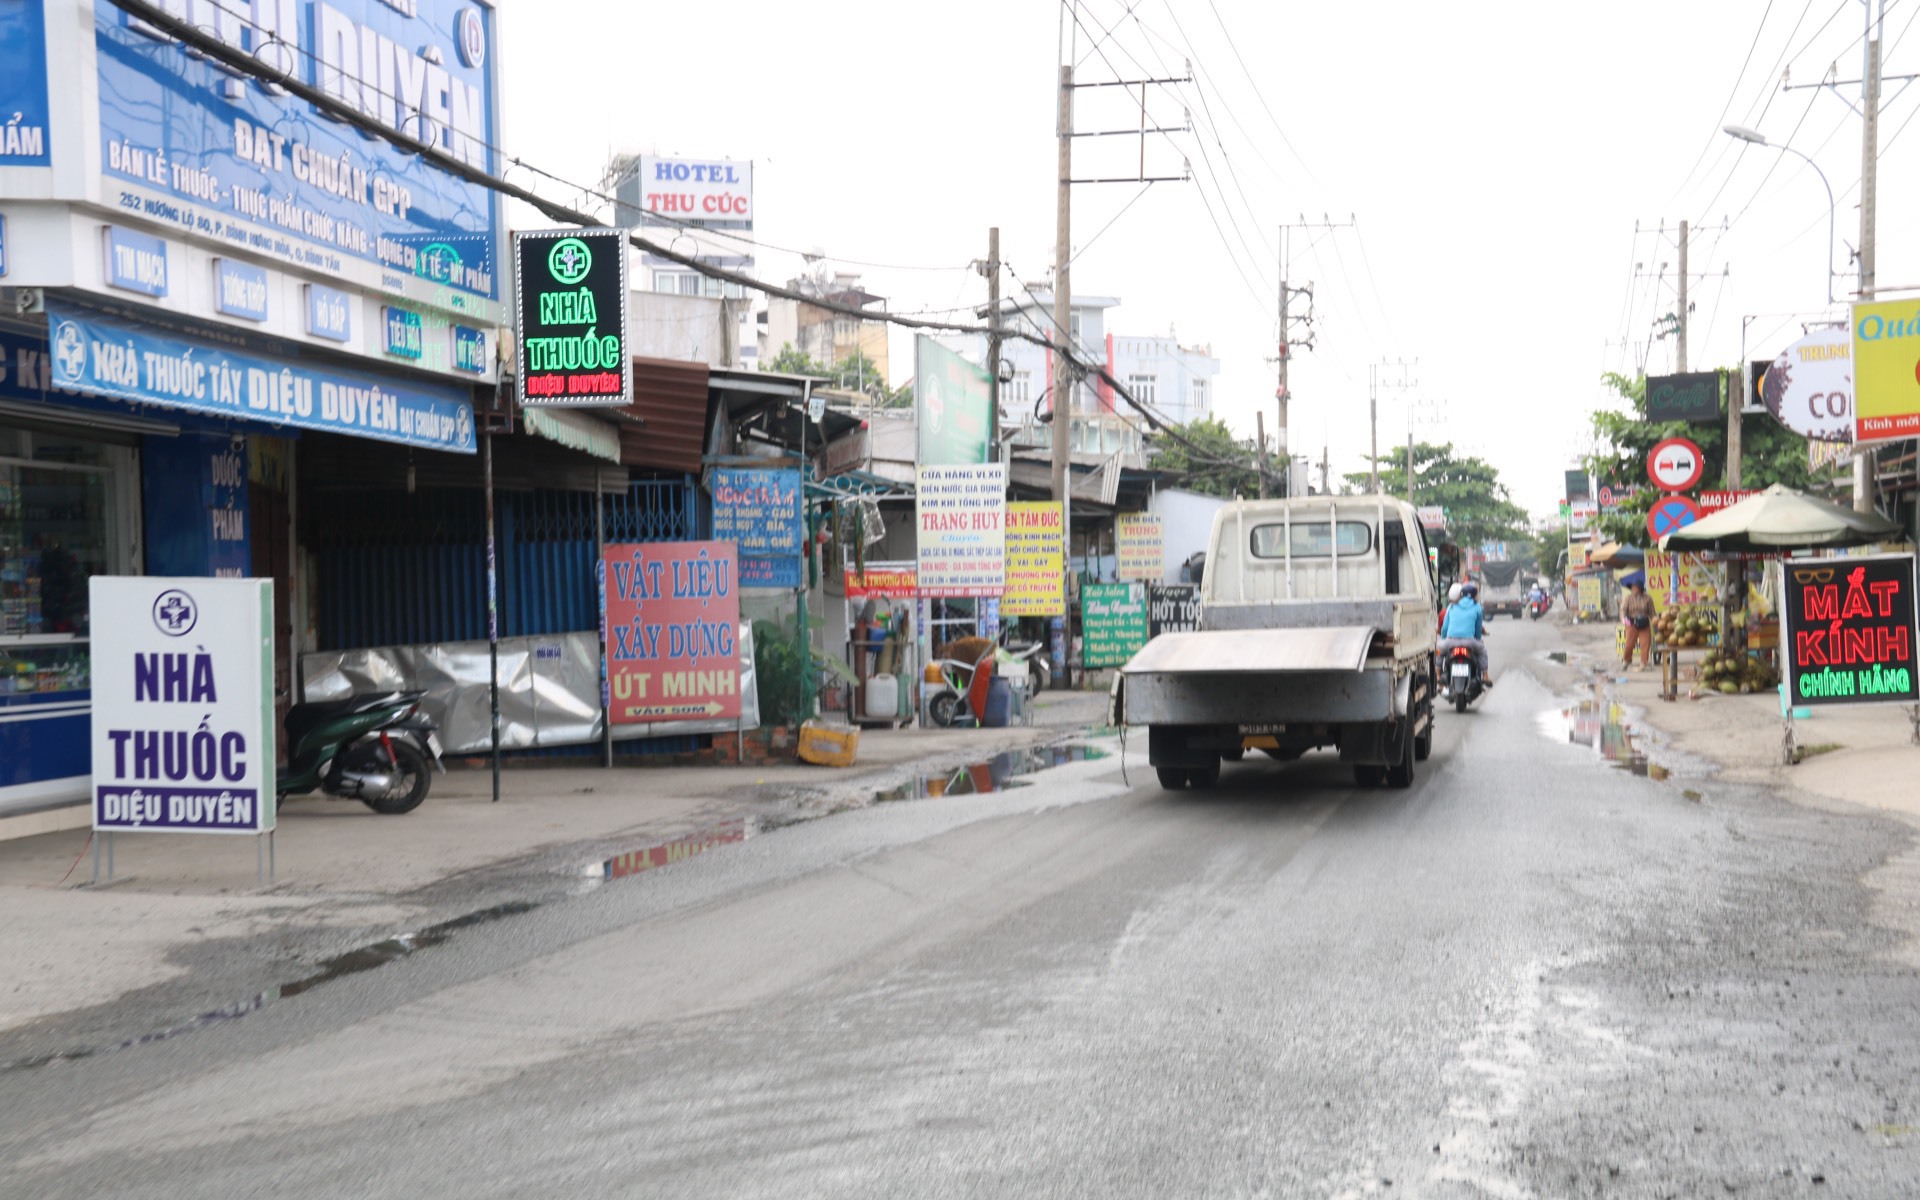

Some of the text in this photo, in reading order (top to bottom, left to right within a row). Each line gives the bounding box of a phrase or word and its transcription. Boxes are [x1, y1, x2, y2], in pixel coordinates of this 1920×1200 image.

[0, 112, 44, 157] ẨM
[234, 117, 412, 220] ĐẠT CHUẨN GPP
[655, 162, 740, 184] HOTEL
[109, 139, 145, 179] BÁN
[146, 147, 167, 186] LẺ
[171, 166, 219, 204] THUỐC
[231, 184, 267, 222] THỰC
[269, 191, 304, 235] PHẨM
[303, 208, 334, 244] CHỨC
[336, 219, 368, 258] NĂNG
[119, 191, 141, 211] 252
[647, 190, 748, 214] THU CÚC
[115, 243, 166, 291] TIM MẠCH
[540, 286, 597, 325] NHÀ
[526, 326, 620, 371] THUỐC
[144, 347, 205, 400] THUỐC
[209, 359, 242, 406] TÂY
[248, 367, 313, 424] DIỆU
[321, 384, 398, 431] DUYÊN
[400, 406, 415, 441] ĐẠT
[441, 419, 456, 441] GPP
[527, 371, 621, 397] DIỆU DUYÊN
[1863, 416, 1893, 431] Kính
[211, 449, 242, 493] DƯỢC
[212, 495, 245, 542] PHẨM
[921, 498, 938, 508] KIM
[1020, 507, 1060, 528] TÂM ĐỨC
[1700, 494, 1722, 507] GIAO
[921, 511, 1000, 531] TRANG HUY
[1122, 525, 1159, 536] TRUNG
[612, 548, 730, 610] VẬT LIỆU
[1803, 566, 1899, 622] MẮT
[1151, 597, 1177, 621] HỚT
[613, 615, 735, 667] XÂY DỰNG
[1796, 618, 1909, 667] KÍNH
[135, 645, 217, 703] NHÀ
[613, 667, 736, 700] ÚT MINH
[1799, 663, 1911, 698] CHÍNH HÃNG
[108, 713, 247, 782] THUỐC
[103, 790, 252, 827] DIỆU DUYÊN
